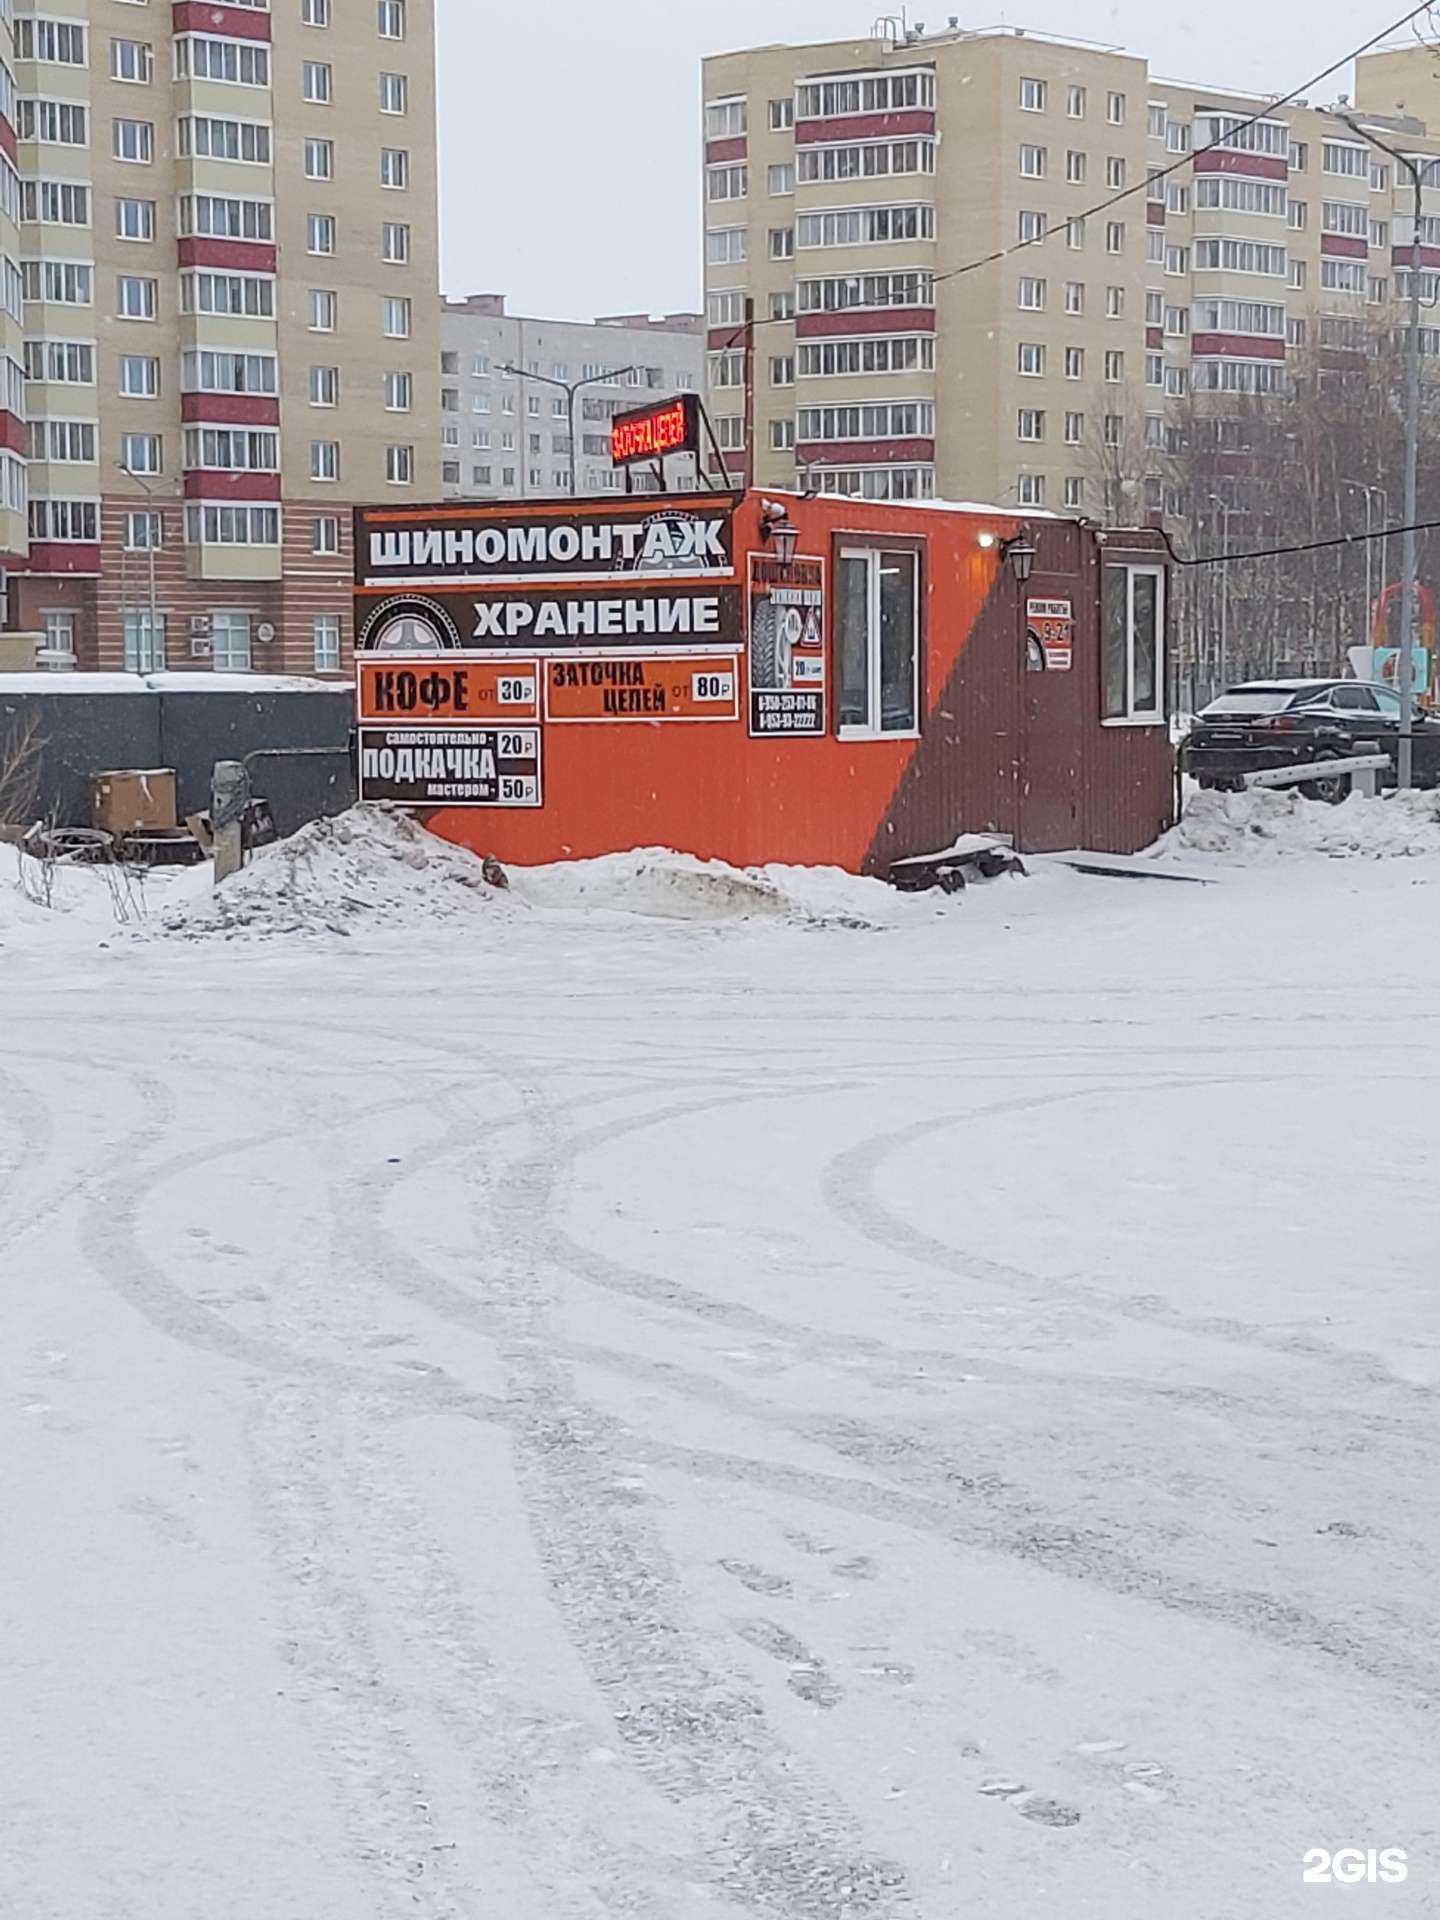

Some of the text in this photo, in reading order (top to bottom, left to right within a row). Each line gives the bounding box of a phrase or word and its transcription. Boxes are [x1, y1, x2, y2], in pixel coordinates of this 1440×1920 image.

[370, 519, 726, 566] ШИНОМОНТАЖ
[472, 597, 720, 637] ХРАНЕНИЕ
[375, 671, 469, 711] КОФЕ
[553, 661, 645, 687] ЗАТОЧКА
[604, 683, 665, 715] ЦЕПЕЙ
[363, 748, 497, 783] ПОДКАЧКА
